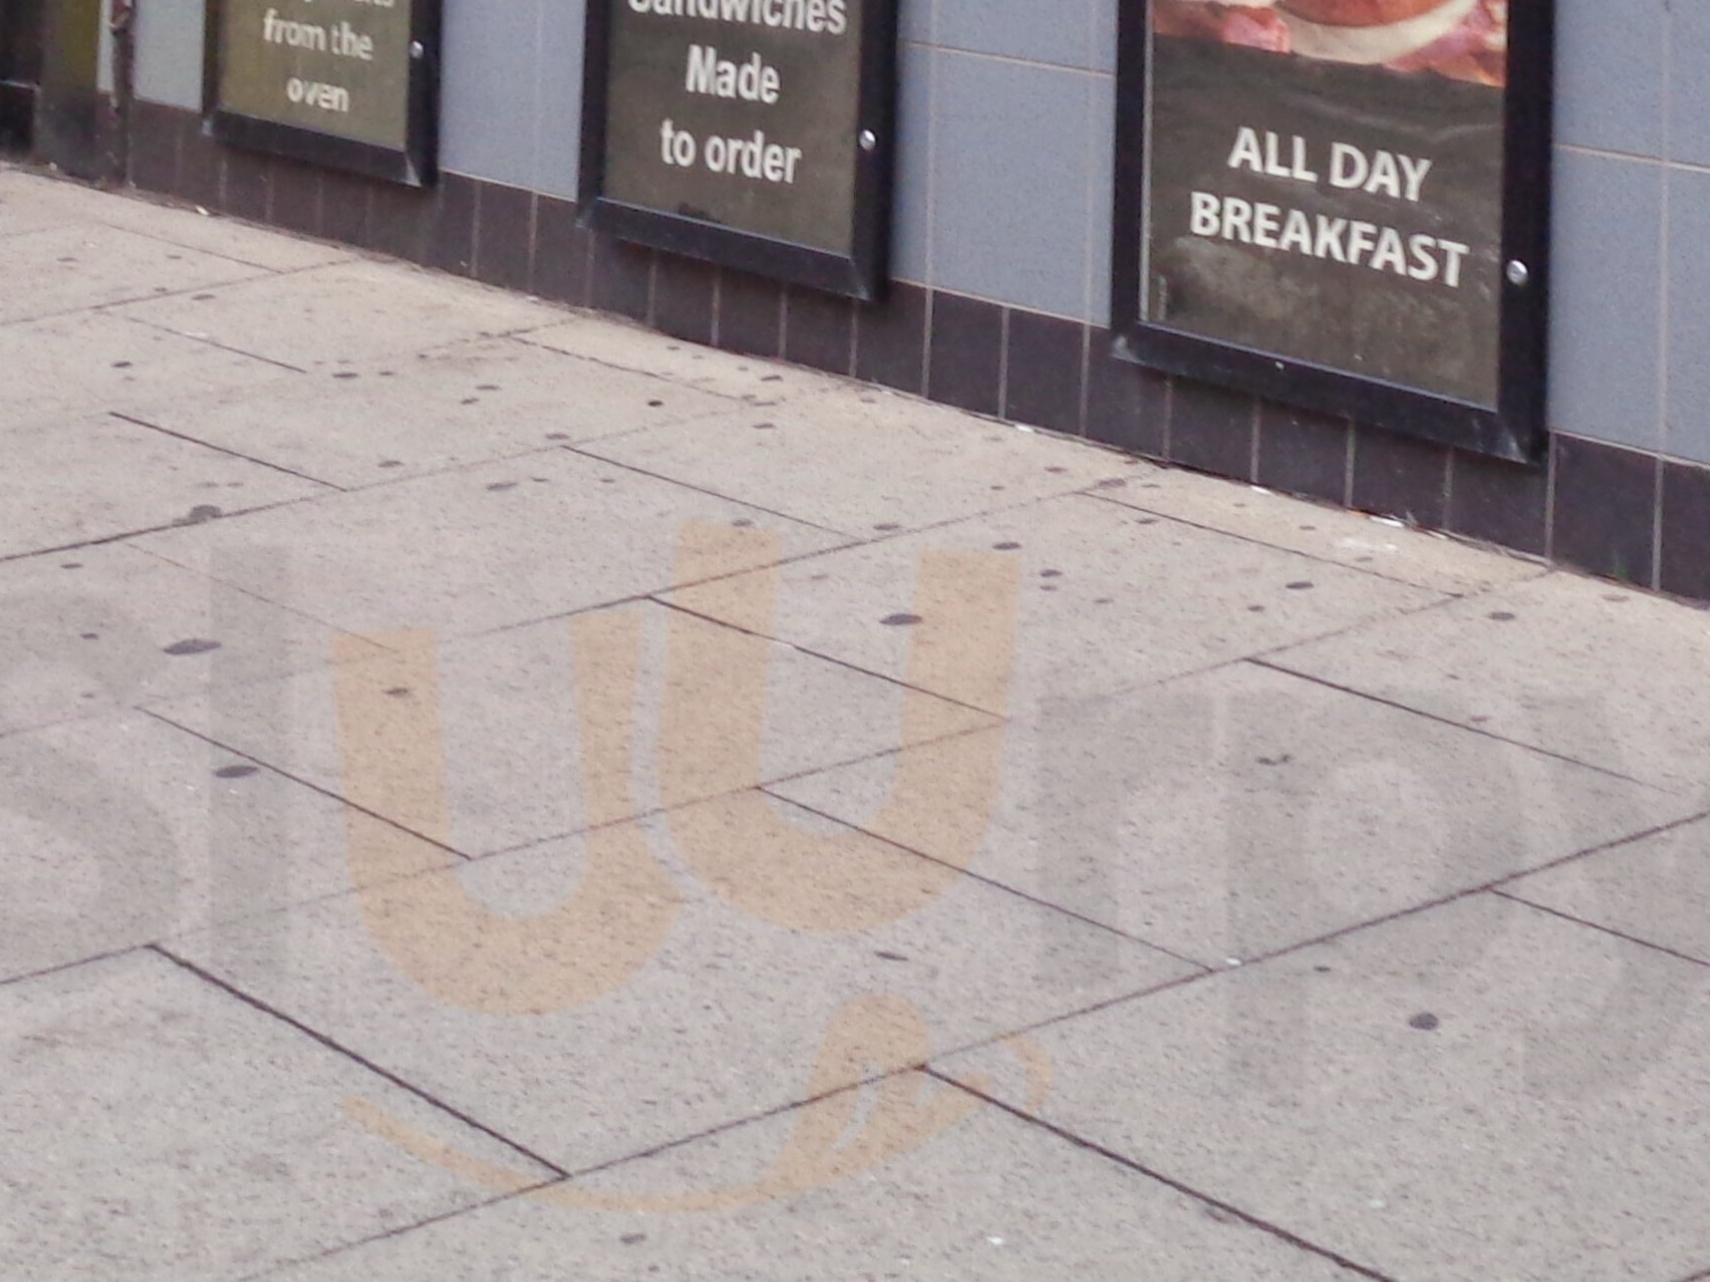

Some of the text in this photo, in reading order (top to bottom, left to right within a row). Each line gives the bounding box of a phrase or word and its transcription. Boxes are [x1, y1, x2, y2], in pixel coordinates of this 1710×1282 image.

[262, 7, 374, 62] from the
[285, 76, 351, 113] oven
[684, 42, 782, 106] Made
[659, 116, 803, 185] to order
[1226, 125, 1434, 203] ALL DAY
[1189, 189, 1472, 288] BREAKFAST
